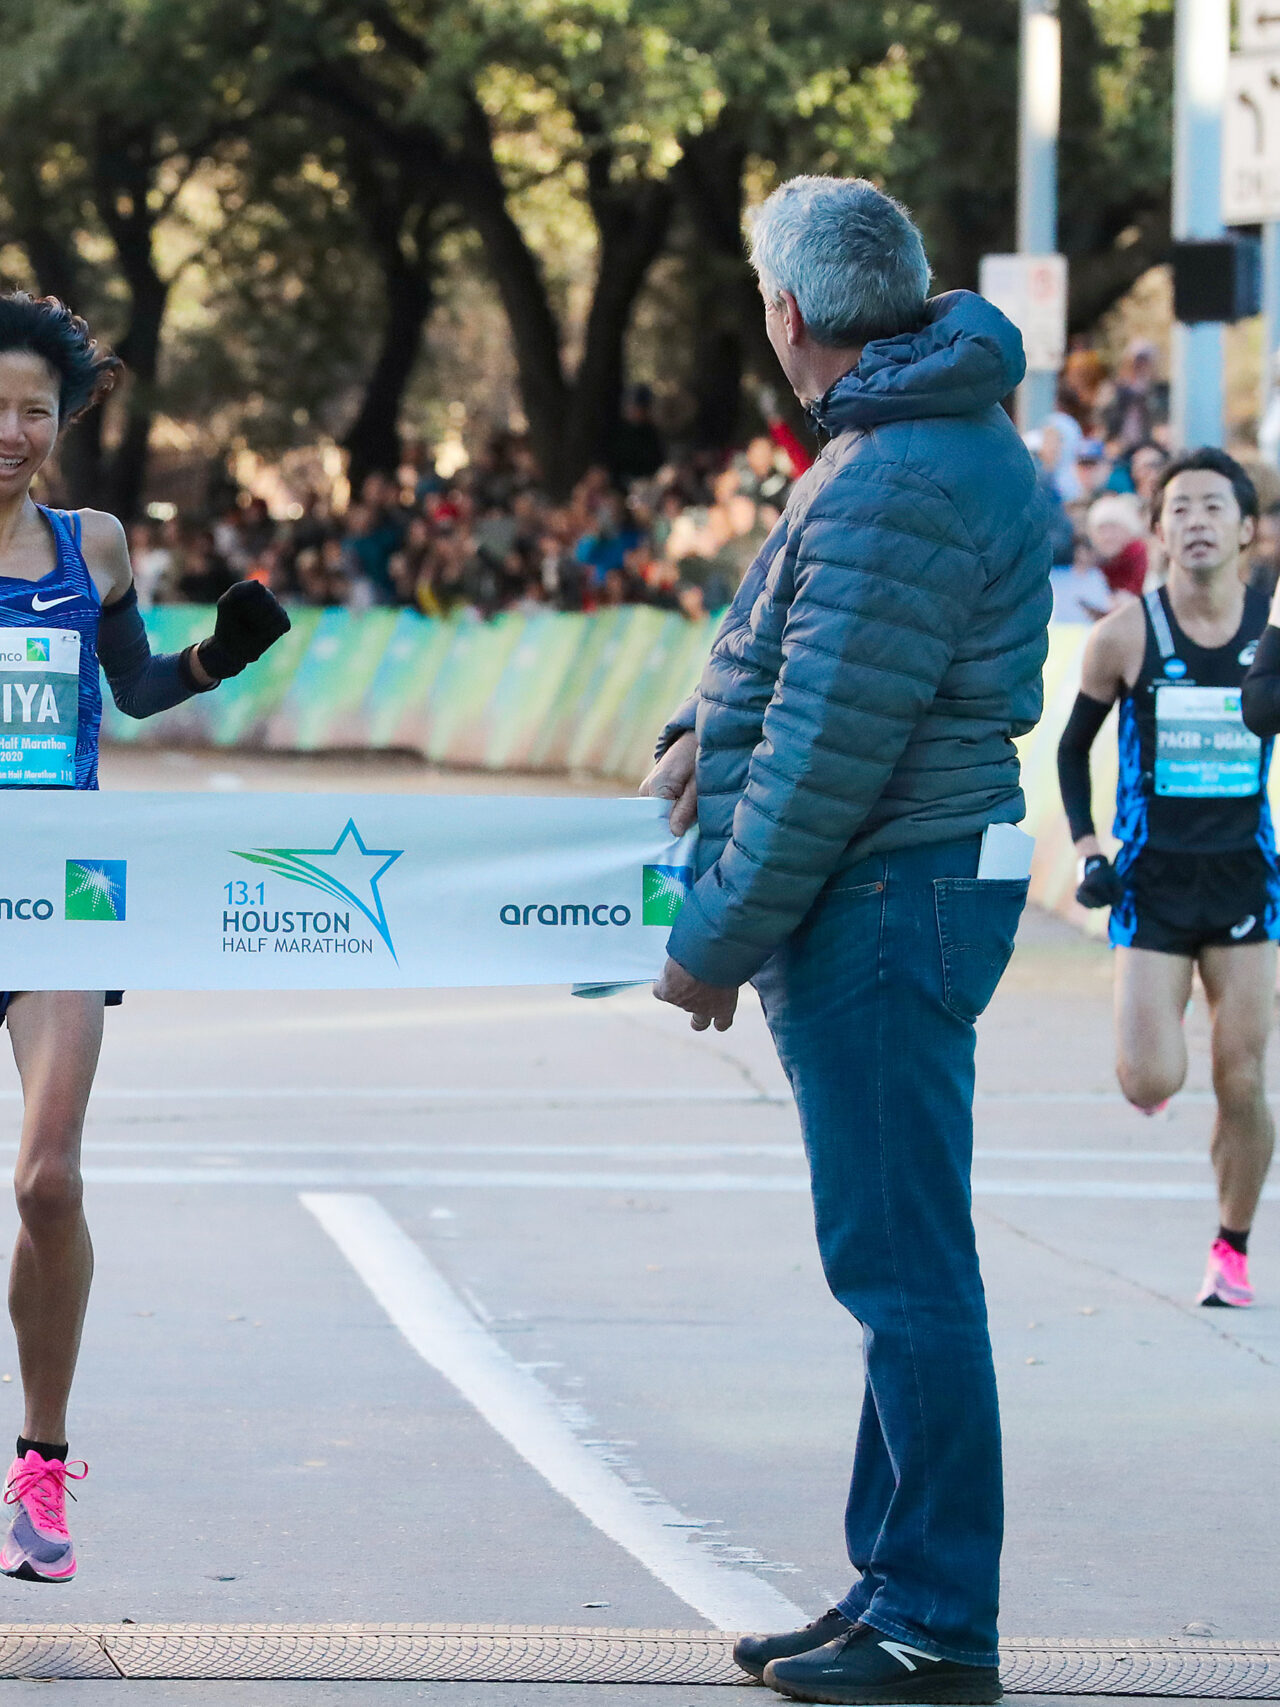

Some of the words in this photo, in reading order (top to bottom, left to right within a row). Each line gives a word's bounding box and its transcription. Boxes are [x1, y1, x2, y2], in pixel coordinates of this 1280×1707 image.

[21, 737, 66, 750] Marathon
[0, 751, 23, 762] 2020
[8, 769, 23, 779] Half
[24, 770, 57, 779] Marathon
[223, 880, 265, 906] 13.1
[223, 910, 350, 934] HOUSTON
[499, 904, 631, 926] aramco
[222, 937, 268, 953] HALF
[274, 937, 373, 954] MARATHON
